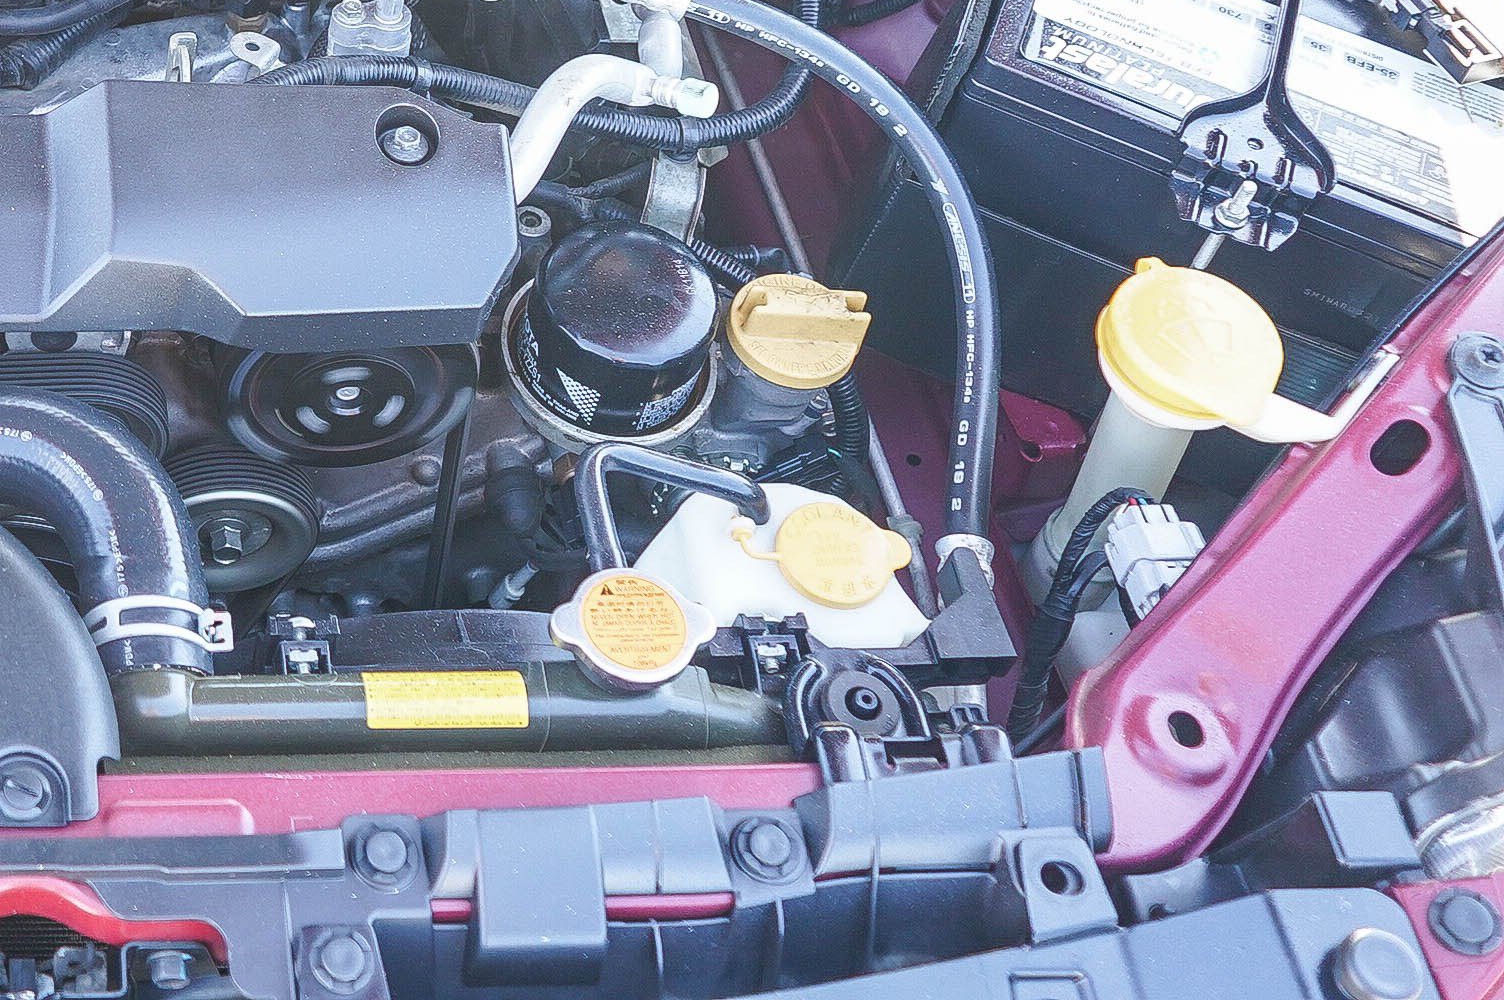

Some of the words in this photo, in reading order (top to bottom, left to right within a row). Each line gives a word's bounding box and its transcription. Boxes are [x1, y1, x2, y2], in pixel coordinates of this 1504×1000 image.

[1216, 5, 1245, 21] 730
[1048, 23, 1166, 78] PLATINUM
[1307, 39, 1329, 54] 35
[735, 19, 756, 35] HP
[835, 72, 863, 96] GD
[867, 96, 891, 119] 19
[891, 121, 910, 139] 2
[1343, 53, 1399, 81] 35-EFB
[965, 309, 974, 329] HP
[957, 419, 969, 447] GD
[953, 460, 965, 484] 19
[950, 497, 962, 512] 2
